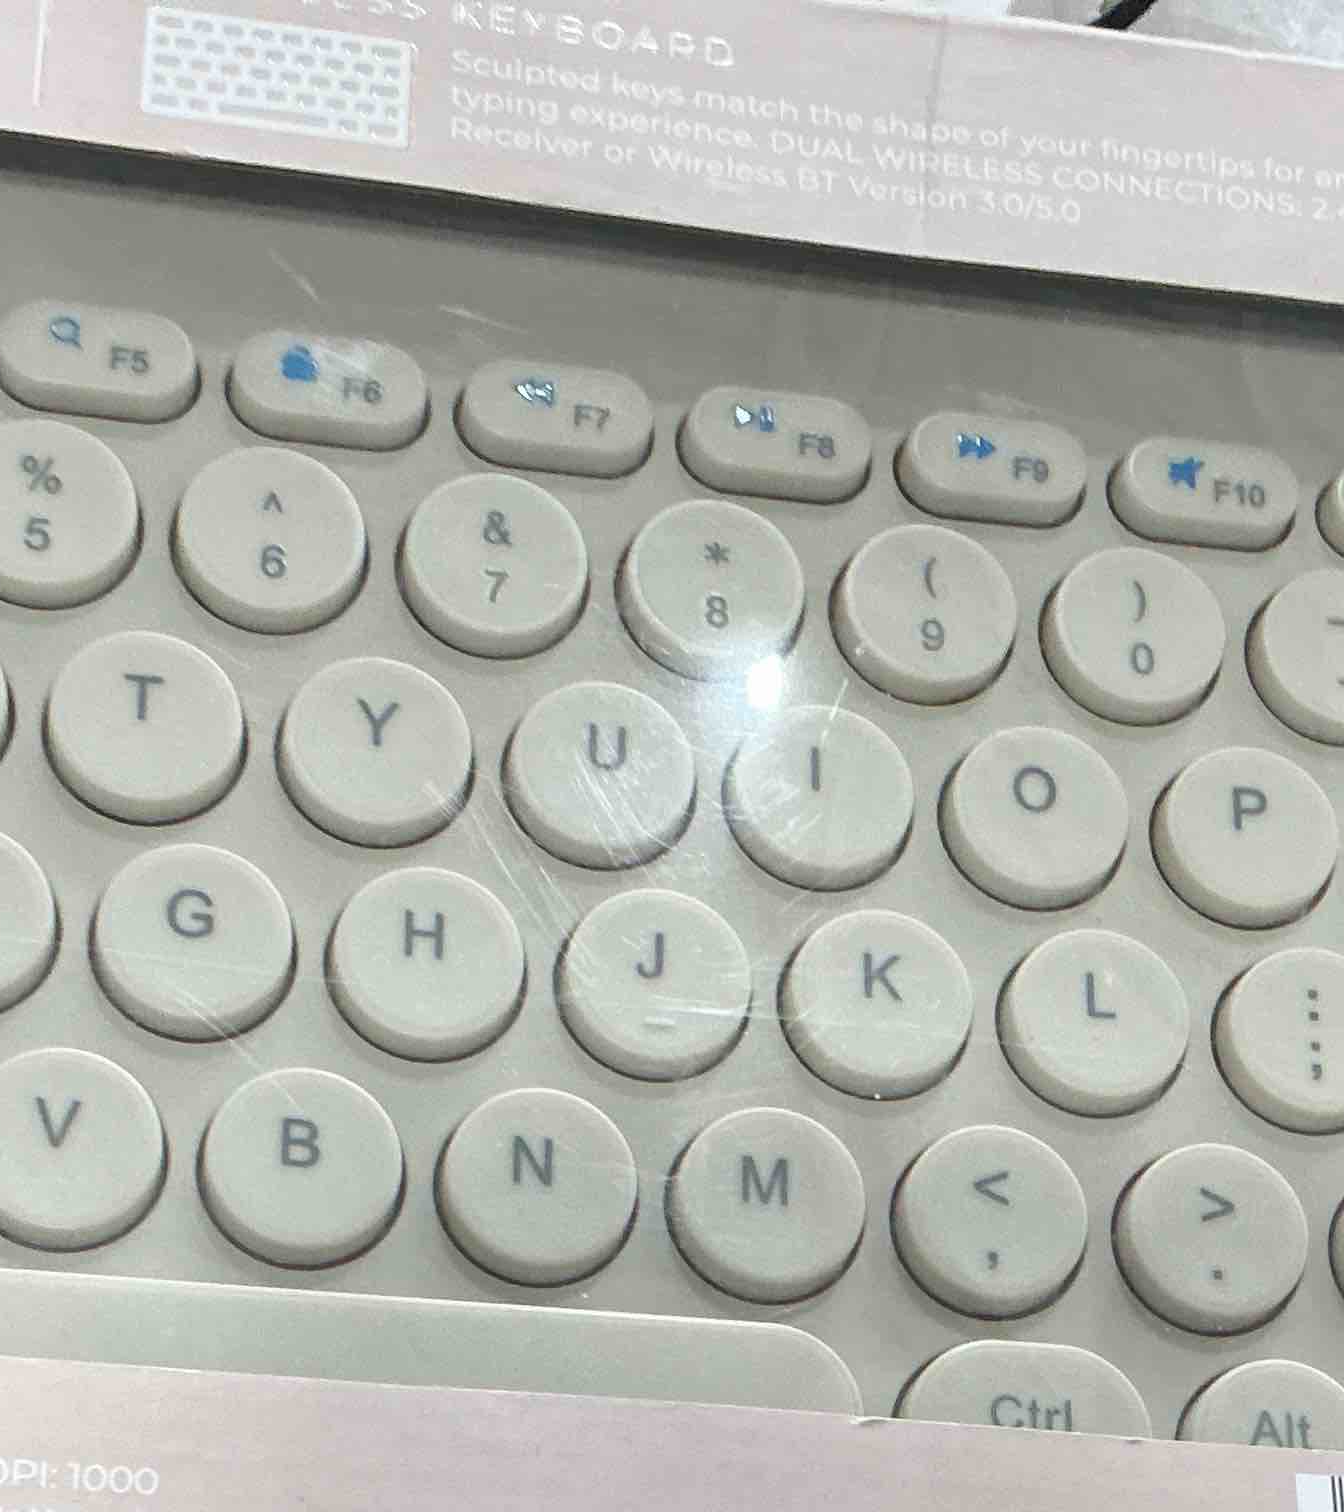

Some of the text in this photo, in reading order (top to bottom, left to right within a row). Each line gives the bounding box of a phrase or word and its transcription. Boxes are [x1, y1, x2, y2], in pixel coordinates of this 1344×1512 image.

[452, 2, 735, 68] KEYBOARD
[450, 48, 600, 95] Sculpted
[612, 72, 689, 108] keys
[695, 89, 801, 123] match
[810, 104, 864, 131] the
[872, 107, 971, 147] shape
[1017, 131, 1093, 160] your
[1101, 137, 1256, 181] fingertips
[1264, 157, 1305, 184] for
[451, 83, 559, 125] typing
[569, 103, 758, 149] experience.
[771, 131, 862, 166] DUAL
[872, 143, 1044, 187] WIRELESS
[450, 117, 1081, 224] Receiver Wireless Version 3.0/5.0
[110, 345, 150, 375] F5
[573, 403, 611, 433] F7
[798, 431, 836, 462] F8
[1012, 454, 1050, 484] F9
[1213, 478, 1266, 508] F10
[123, 673, 165, 721] T
[357, 698, 400, 748] Y
[587, 721, 628, 772] U
[1231, 786, 1269, 832] P
[165, 888, 215, 940] G
[402, 909, 446, 961] H
[636, 931, 665, 980] J
[862, 951, 904, 1003] K
[1084, 970, 1117, 1021] L
[35, 1096, 83, 1150] V
[279, 1116, 322, 1170] B
[512, 1135, 555, 1188] N
[740, 1155, 790, 1208] M
[989, 1393, 1074, 1434] Ctrl
[1247, 1408, 1312, 1450] Alt
[67, 1460, 160, 1496] 1000
